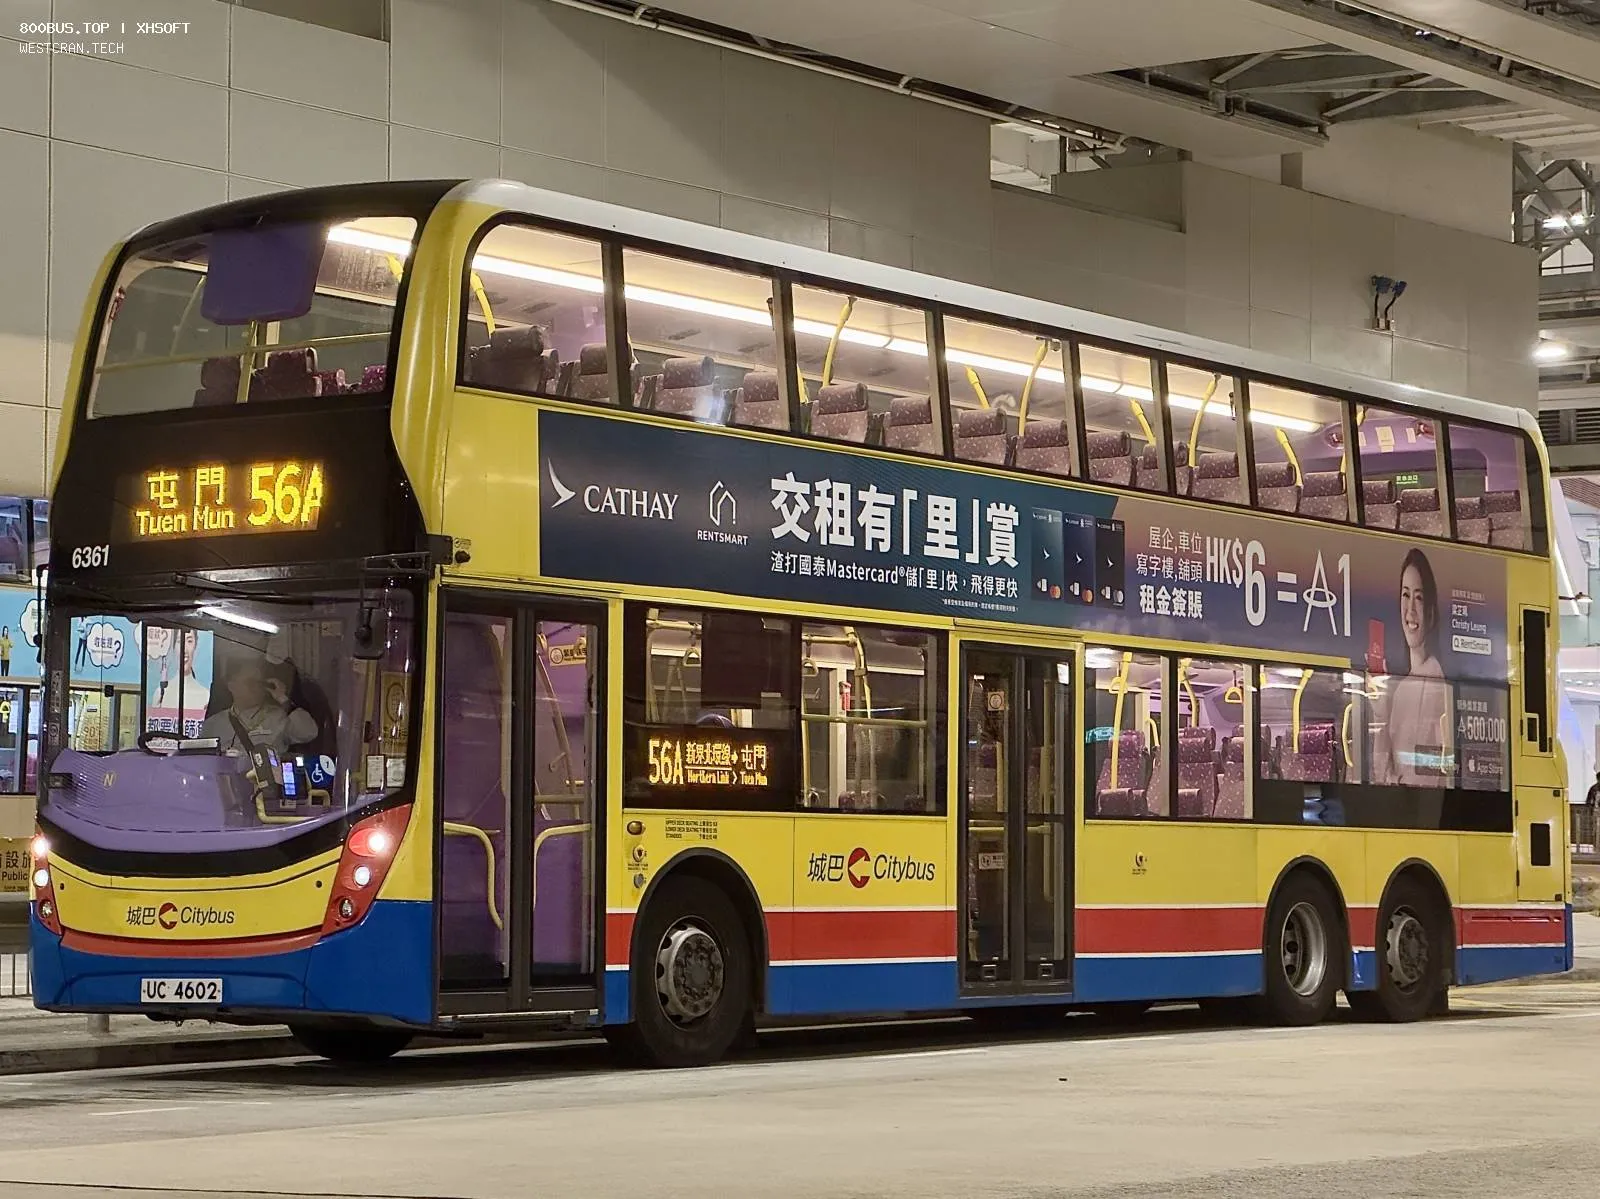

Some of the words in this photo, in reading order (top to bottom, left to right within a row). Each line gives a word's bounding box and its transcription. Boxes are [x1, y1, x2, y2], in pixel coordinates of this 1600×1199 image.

[147, 466, 226, 509] 屯門
[248, 463, 324, 527] 56A
[584, 485, 679, 520] CATHAY
[136, 509, 187, 536] Tuen
[193, 507, 235, 531] Mun
[770, 471, 1019, 568] 交租有「里」賞
[697, 530, 749, 546] RENTSMART
[72, 545, 110, 569] 6361
[1206, 537, 1267, 627] HK$6
[649, 740, 684, 784] 56A
[741, 744, 767, 771] 屯門
[1, 871, 28, 881] Public
[807, 852, 845, 882] 城巴
[874, 854, 936, 883] Citybus
[126, 906, 156, 926] 城巴
[180, 906, 235, 926] Citybus
[146, 981, 166, 999] UC
[174, 981, 217, 1000] 4602
